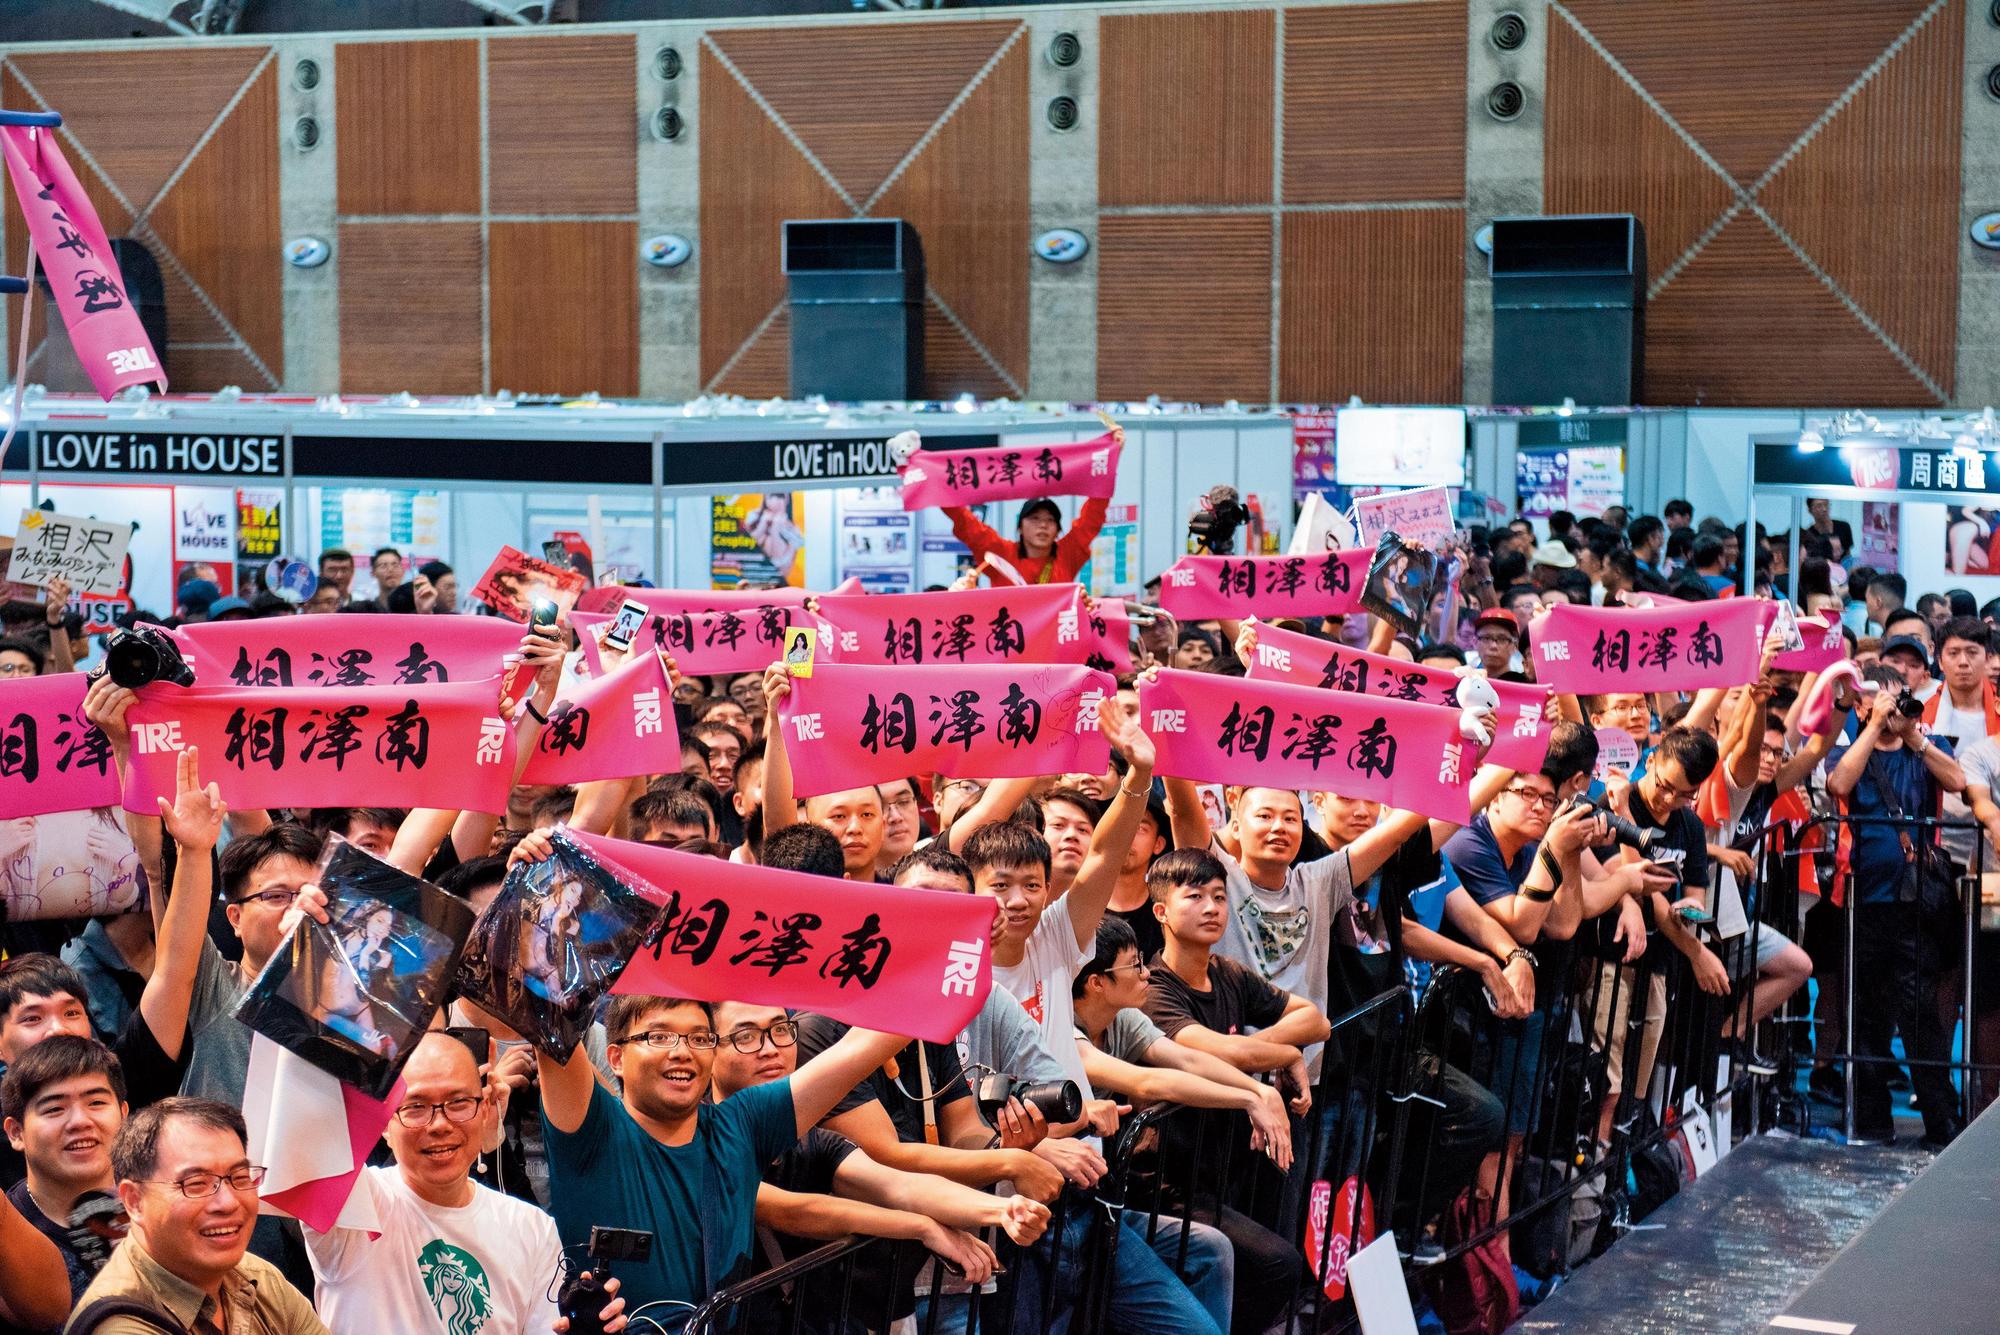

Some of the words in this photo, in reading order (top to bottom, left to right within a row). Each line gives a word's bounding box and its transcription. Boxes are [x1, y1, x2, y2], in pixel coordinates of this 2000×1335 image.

[43, 434, 121, 468] LOVE
[130, 435, 156, 469] in
[167, 437, 279, 472] HOUSE
[774, 444, 823, 478] LOVE
[828, 444, 845, 476] in
[946, 448, 1063, 490] 相澤南
[38, 523, 113, 560] 相沢
[1218, 553, 1350, 598] 相澤南
[884, 607, 1025, 664] 相澤南
[1592, 622, 1723, 672] 相澤南
[225, 699, 429, 771] 相澤南
[861, 683, 1041, 754] 相澤南
[1217, 700, 1398, 779] 相澤南
[645, 890, 892, 990] 相澤南
